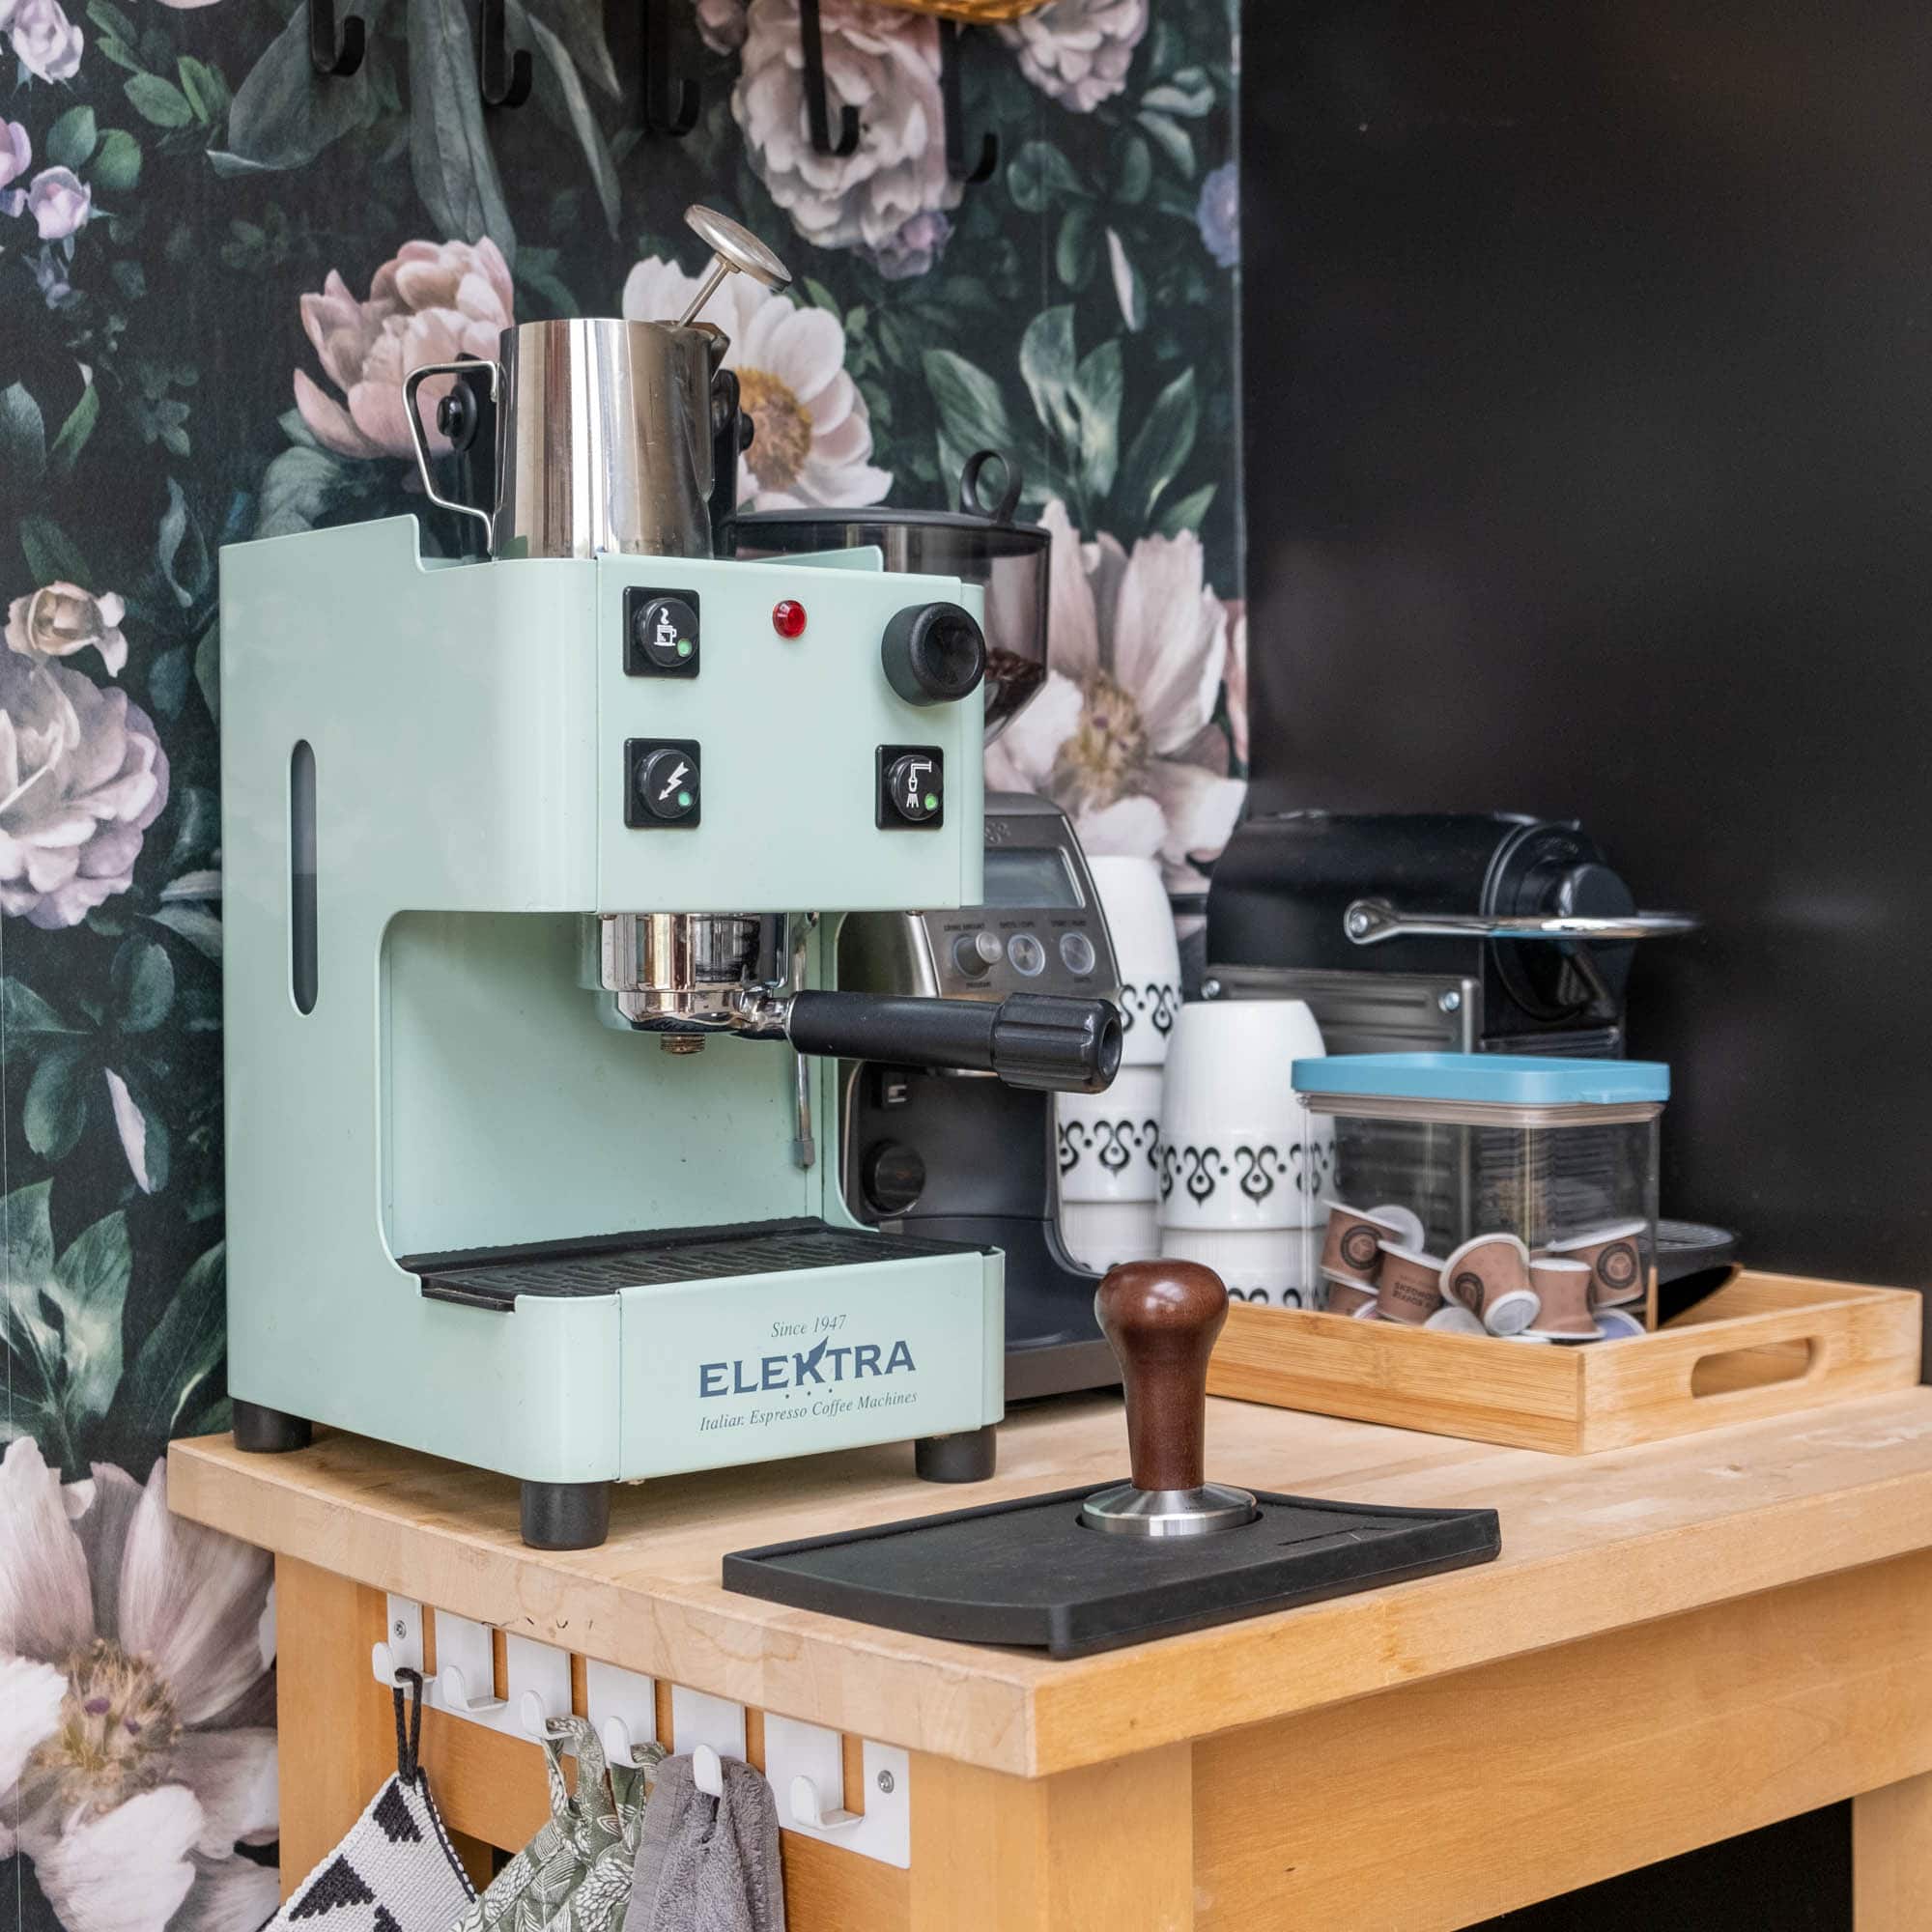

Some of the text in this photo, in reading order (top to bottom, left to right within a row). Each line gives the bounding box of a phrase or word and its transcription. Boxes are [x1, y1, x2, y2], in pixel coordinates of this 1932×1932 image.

[770, 1314, 847, 1338] Since 1947
[698, 1335, 917, 1399] ELEKTRA
[749, 1406, 808, 1427] Espresso
[811, 1399, 853, 1418] Coffee
[857, 1391, 918, 1410] Machines
